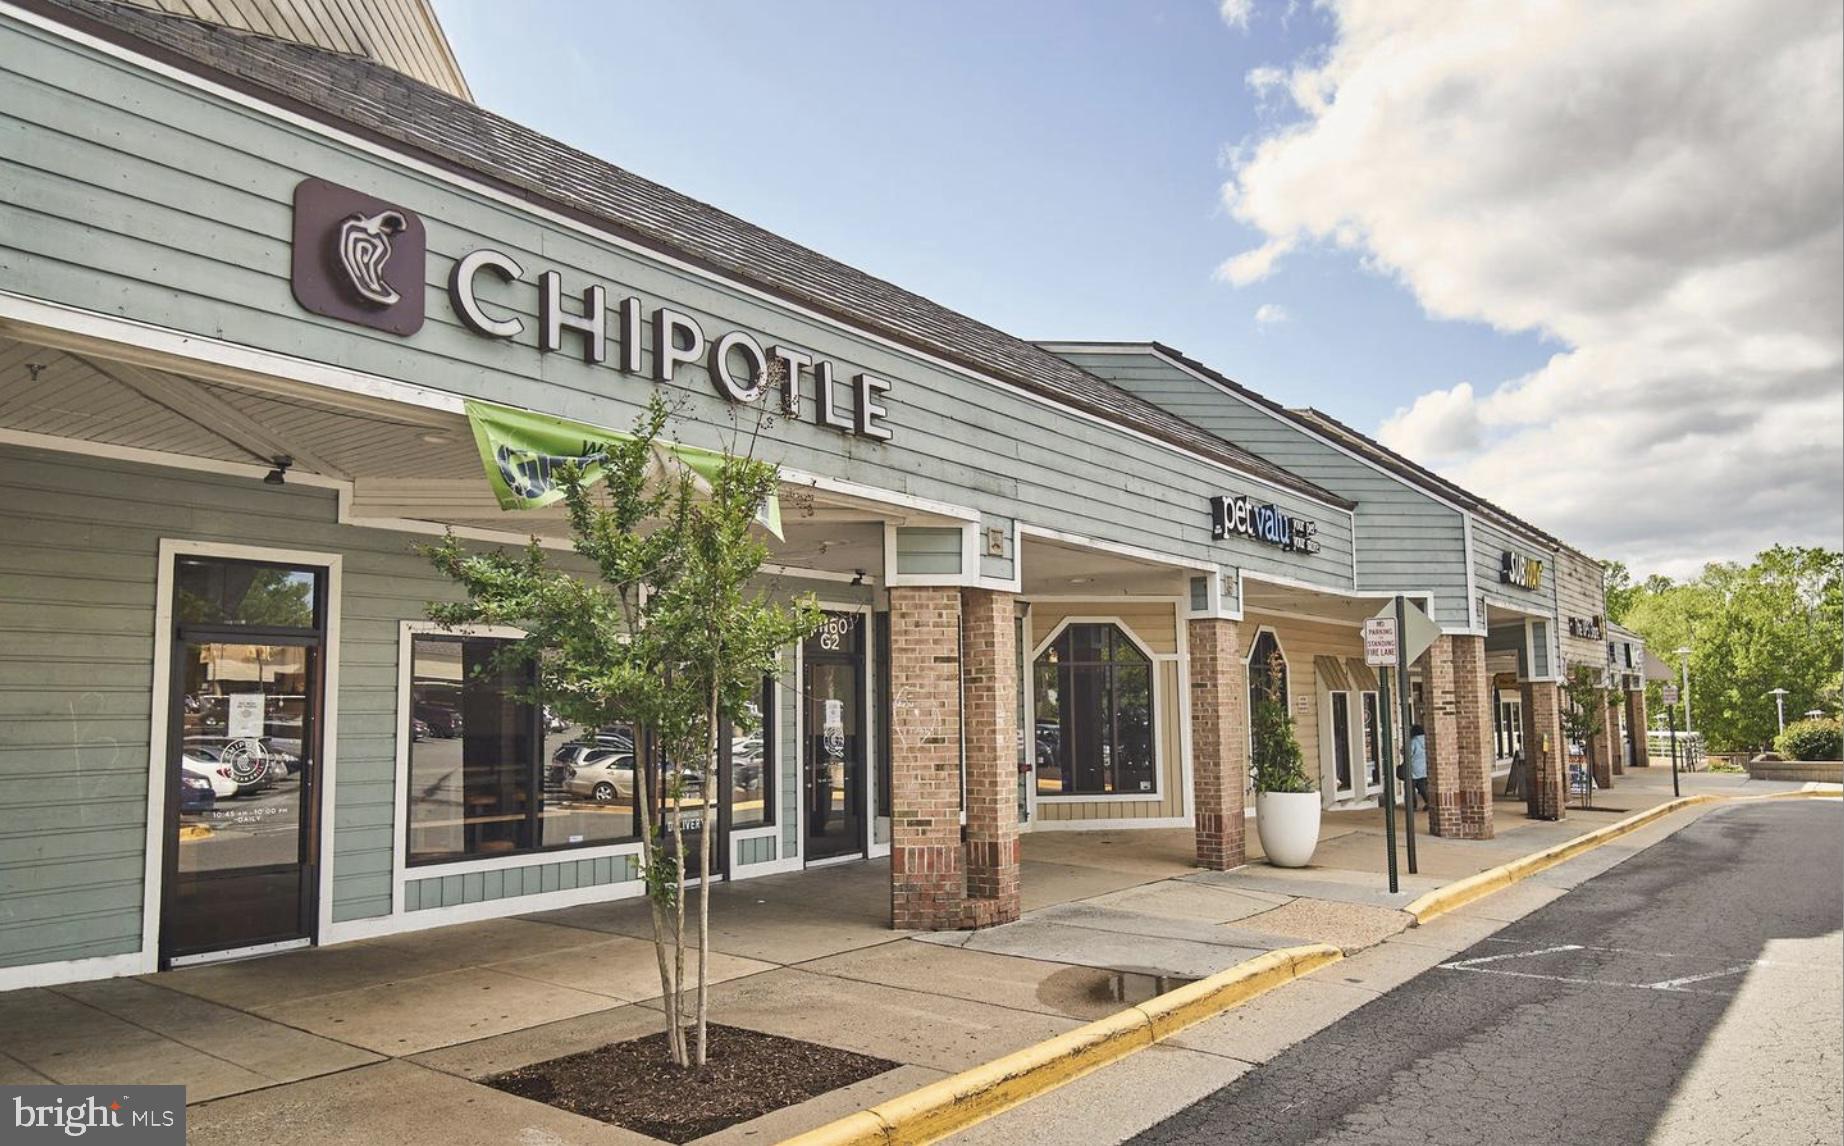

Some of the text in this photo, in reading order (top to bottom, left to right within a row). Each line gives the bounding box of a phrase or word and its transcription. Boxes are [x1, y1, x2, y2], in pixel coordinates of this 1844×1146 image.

[448, 249, 893, 441] CHIPOTLE
[1222, 496, 1290, 544] pet valu
[820, 633, 840, 650] G2
[1380, 648, 1395, 656] LANE
[667, 818, 705, 832] DIVER
